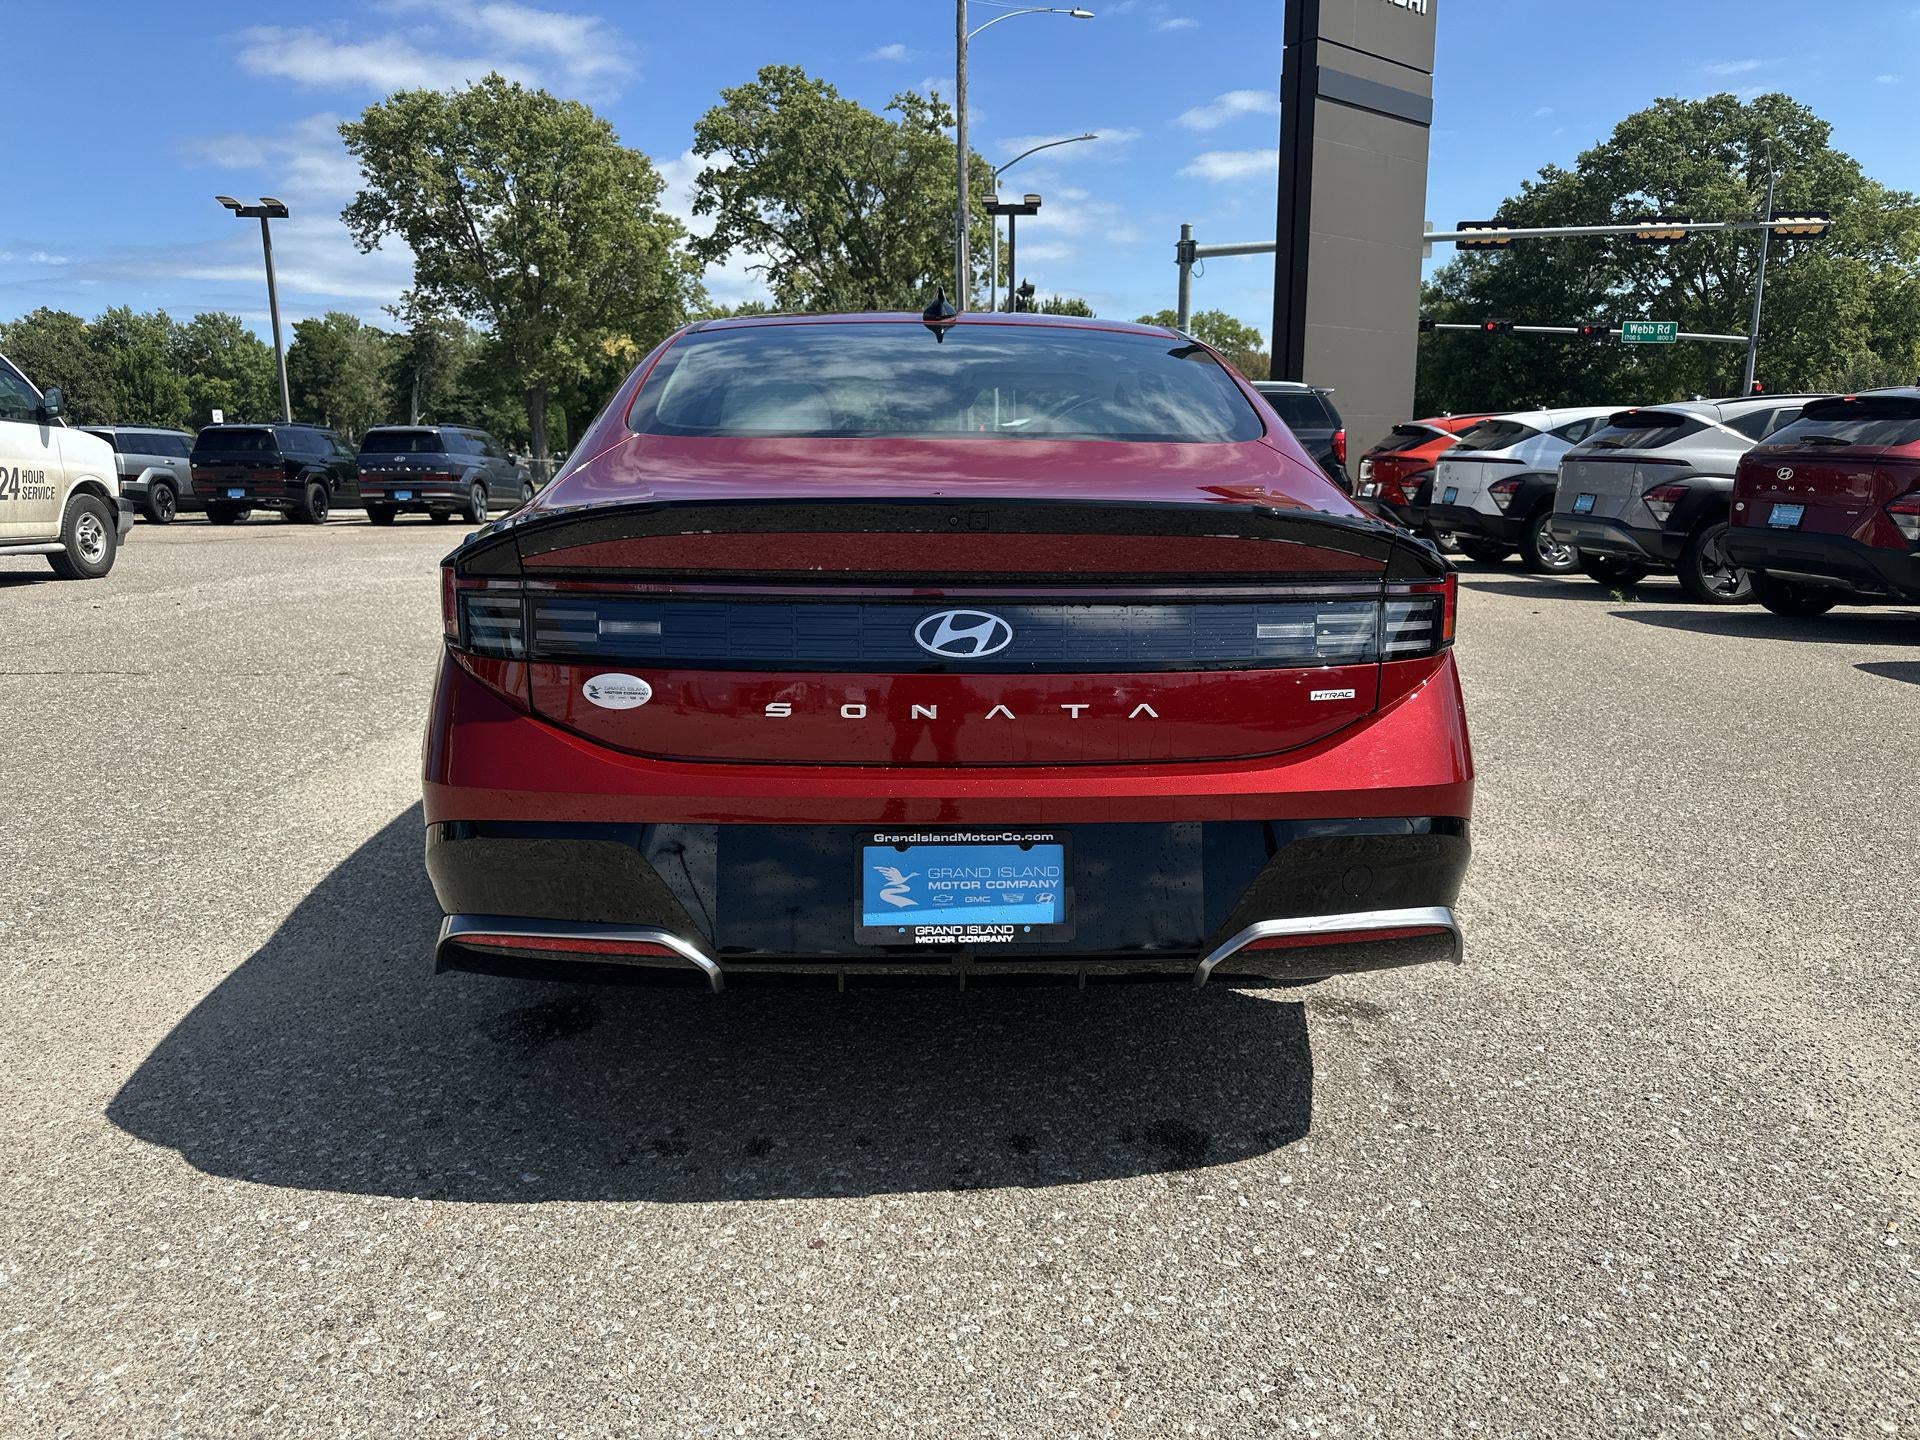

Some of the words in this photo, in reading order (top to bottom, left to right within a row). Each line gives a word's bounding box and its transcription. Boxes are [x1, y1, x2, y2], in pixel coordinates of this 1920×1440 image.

[1630, 324, 1654, 334] Webb
[1657, 324, 1670, 334] Rd
[22, 470, 45, 484] HOUR
[0, 466, 20, 501] 24
[1756, 484, 1815, 492] KONA
[22, 486, 55, 500] SERVICE
[1314, 691, 1352, 699] HTRAC
[765, 702, 1159, 720] SONATA
[873, 832, 1054, 843] GrandIslandMotorCo.com
[928, 867, 991, 879] GRAND
[997, 866, 1060, 878] ISLAND
[928, 881, 981, 890] MOTOR
[986, 879, 1059, 889] COMPANY
[964, 895, 991, 903] GMC
[915, 925, 963, 935] GRAND
[967, 925, 1014, 934] ISLAND
[915, 935, 956, 944] MOTOR
[958, 935, 1014, 943] COMPANY
